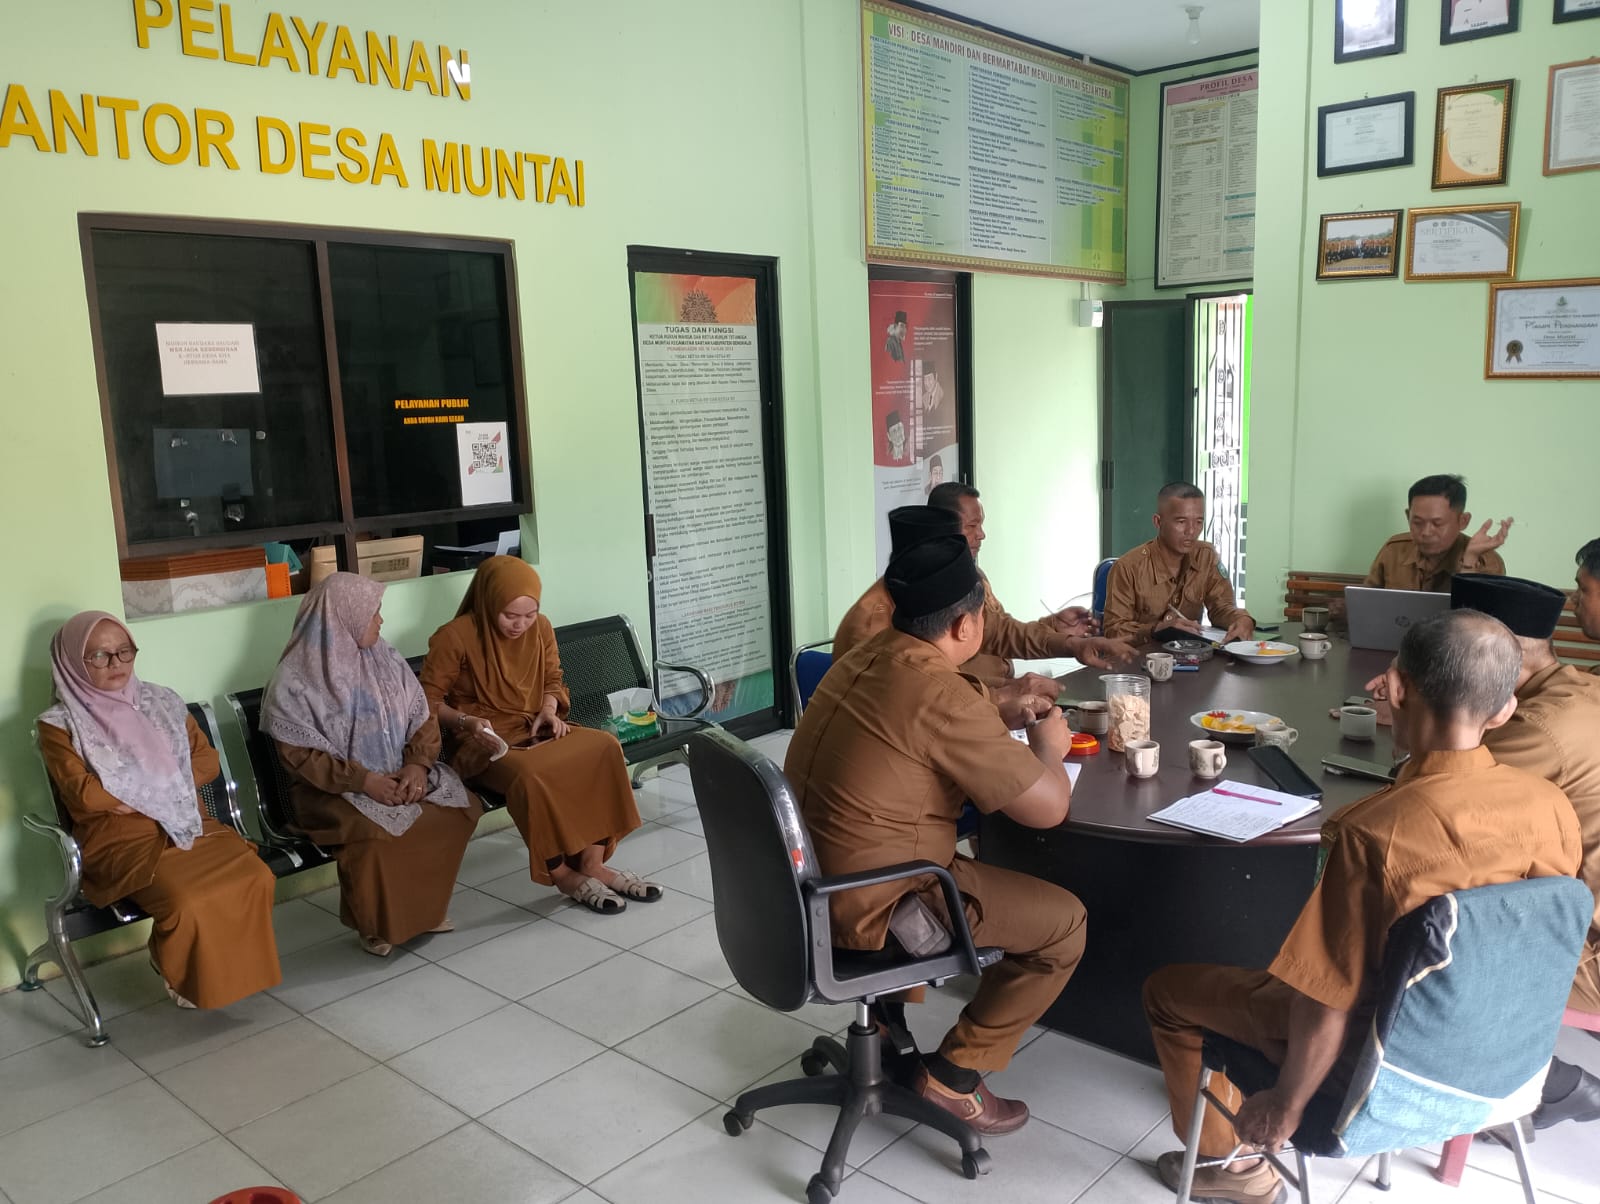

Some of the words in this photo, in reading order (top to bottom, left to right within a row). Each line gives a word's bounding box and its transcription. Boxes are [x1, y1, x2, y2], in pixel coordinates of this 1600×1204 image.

[133, 0, 471, 101] PELAYANAN
[888, 23, 904, 38] VISI
[911, 30, 931, 46] DESA
[933, 37, 965, 57] MANDIRI
[966, 48, 981, 61] DAN
[982, 52, 1030, 76] BERMARTABAT
[1031, 65, 1057, 84] MENUJU
[1200, 79, 1228, 91] PROFIL
[1231, 75, 1253, 85] DESA
[0, 83, 241, 170] ANTOR
[256, 115, 410, 190] DESA
[422, 138, 586, 208] MUNTAI
[664, 326, 690, 334] TUGAS
[691, 326, 707, 334] DAN
[395, 399, 440, 408] PELAYANAN
[441, 398, 469, 408] PUBLIK
